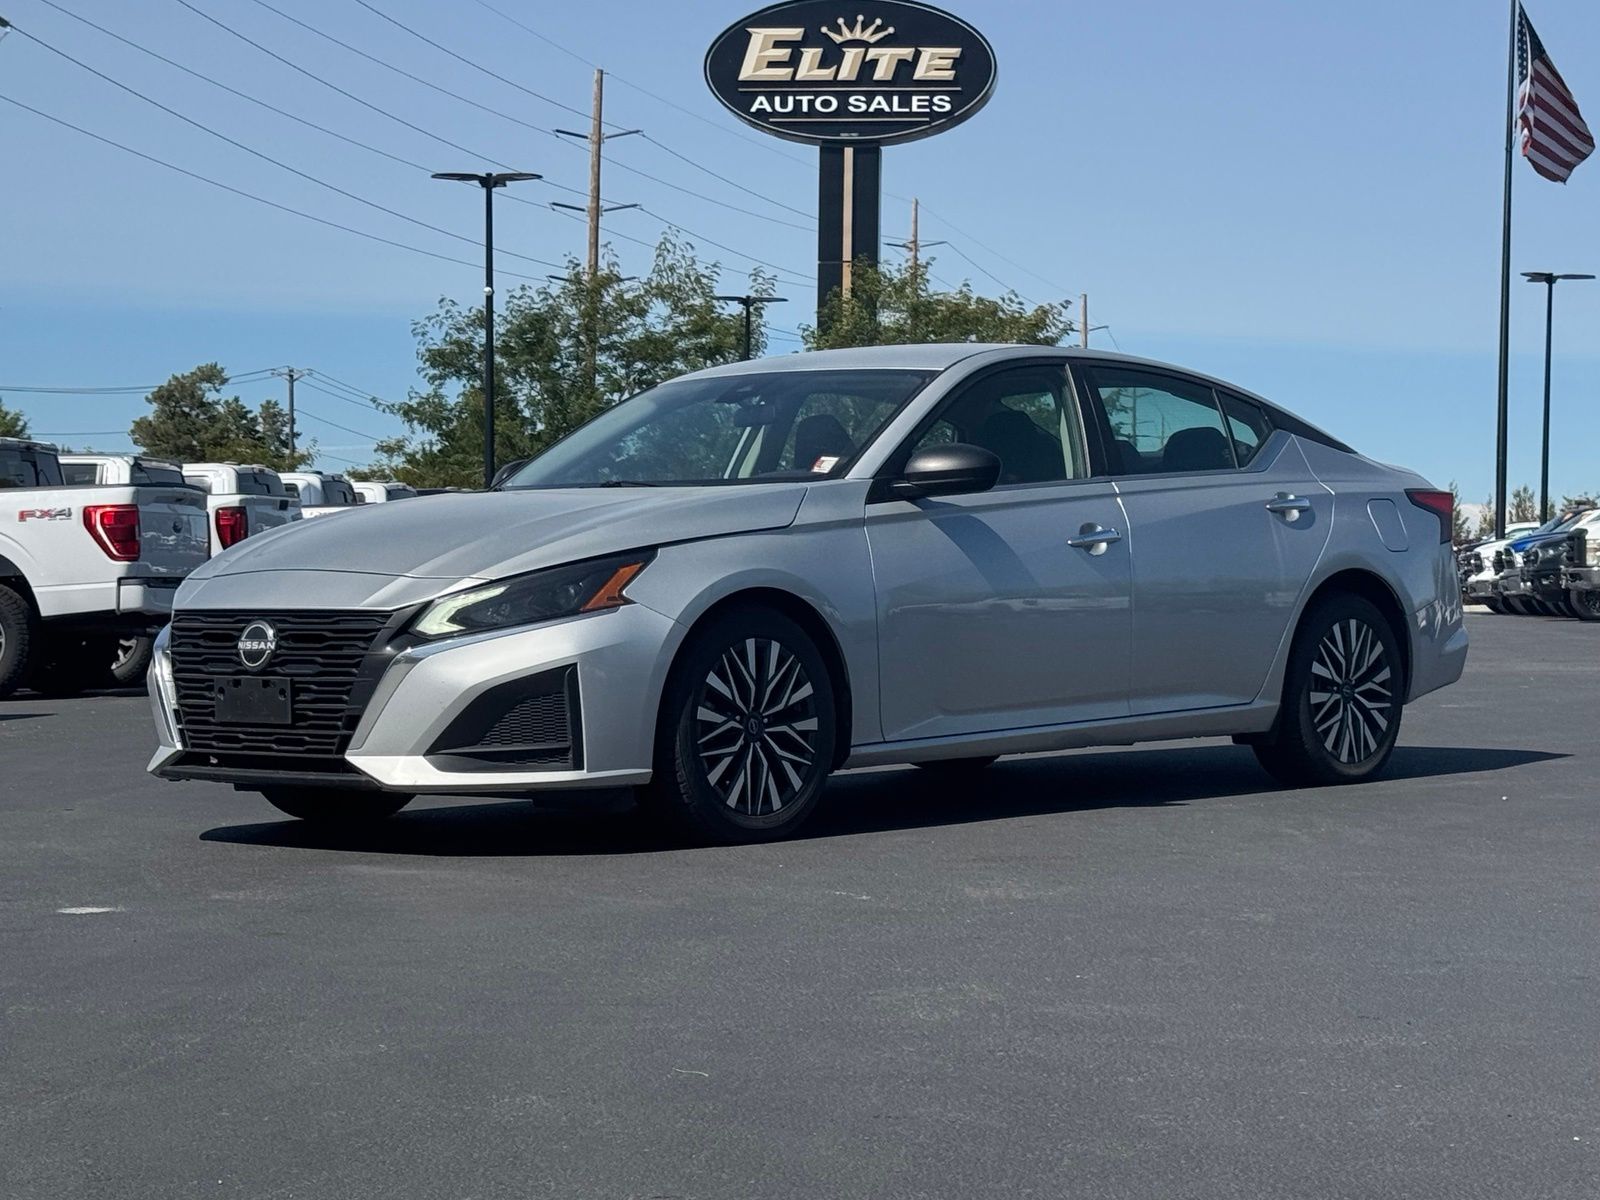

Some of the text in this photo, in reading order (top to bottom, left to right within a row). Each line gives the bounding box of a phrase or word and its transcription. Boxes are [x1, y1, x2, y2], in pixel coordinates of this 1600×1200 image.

[750, 95, 951, 112] AUTO SALES
[18, 507, 72, 522] FX4
[237, 641, 276, 650] NISSAN
